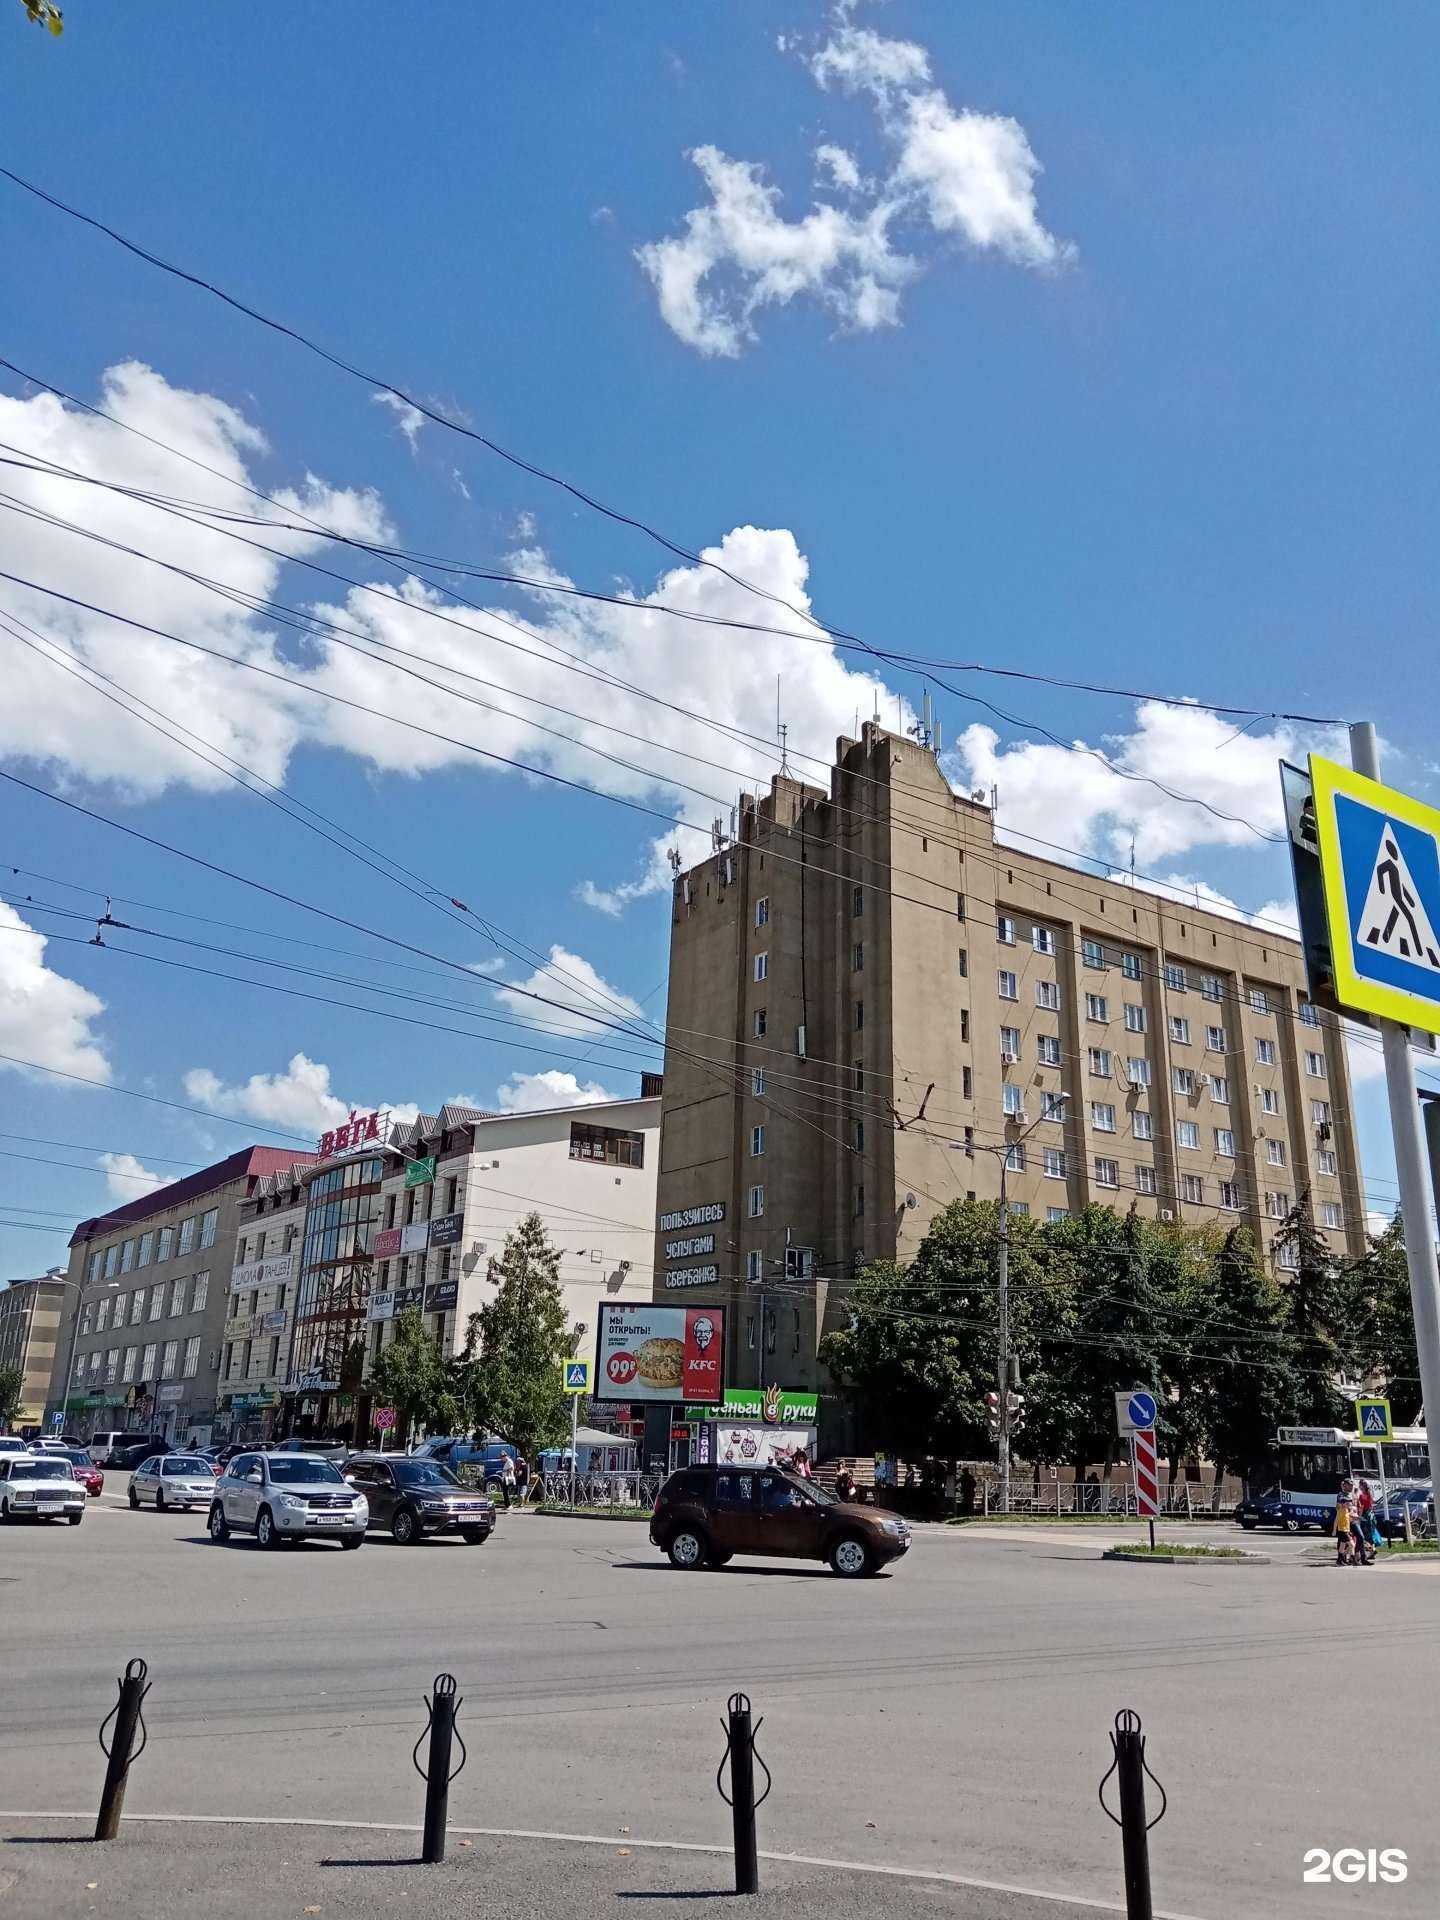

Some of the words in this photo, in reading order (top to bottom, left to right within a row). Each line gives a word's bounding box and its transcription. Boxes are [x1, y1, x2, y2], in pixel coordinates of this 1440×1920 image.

[319, 1111, 380, 1158] ВЕГА
[609, 1316, 624, 1325] МЫ
[608, 1325, 651, 1335] ОТКРЫТЫ!
[688, 1359, 716, 1371] KFC
[1281, 1491, 1292, 1503] 60
[1295, 1507, 1323, 1518] ОФИС
